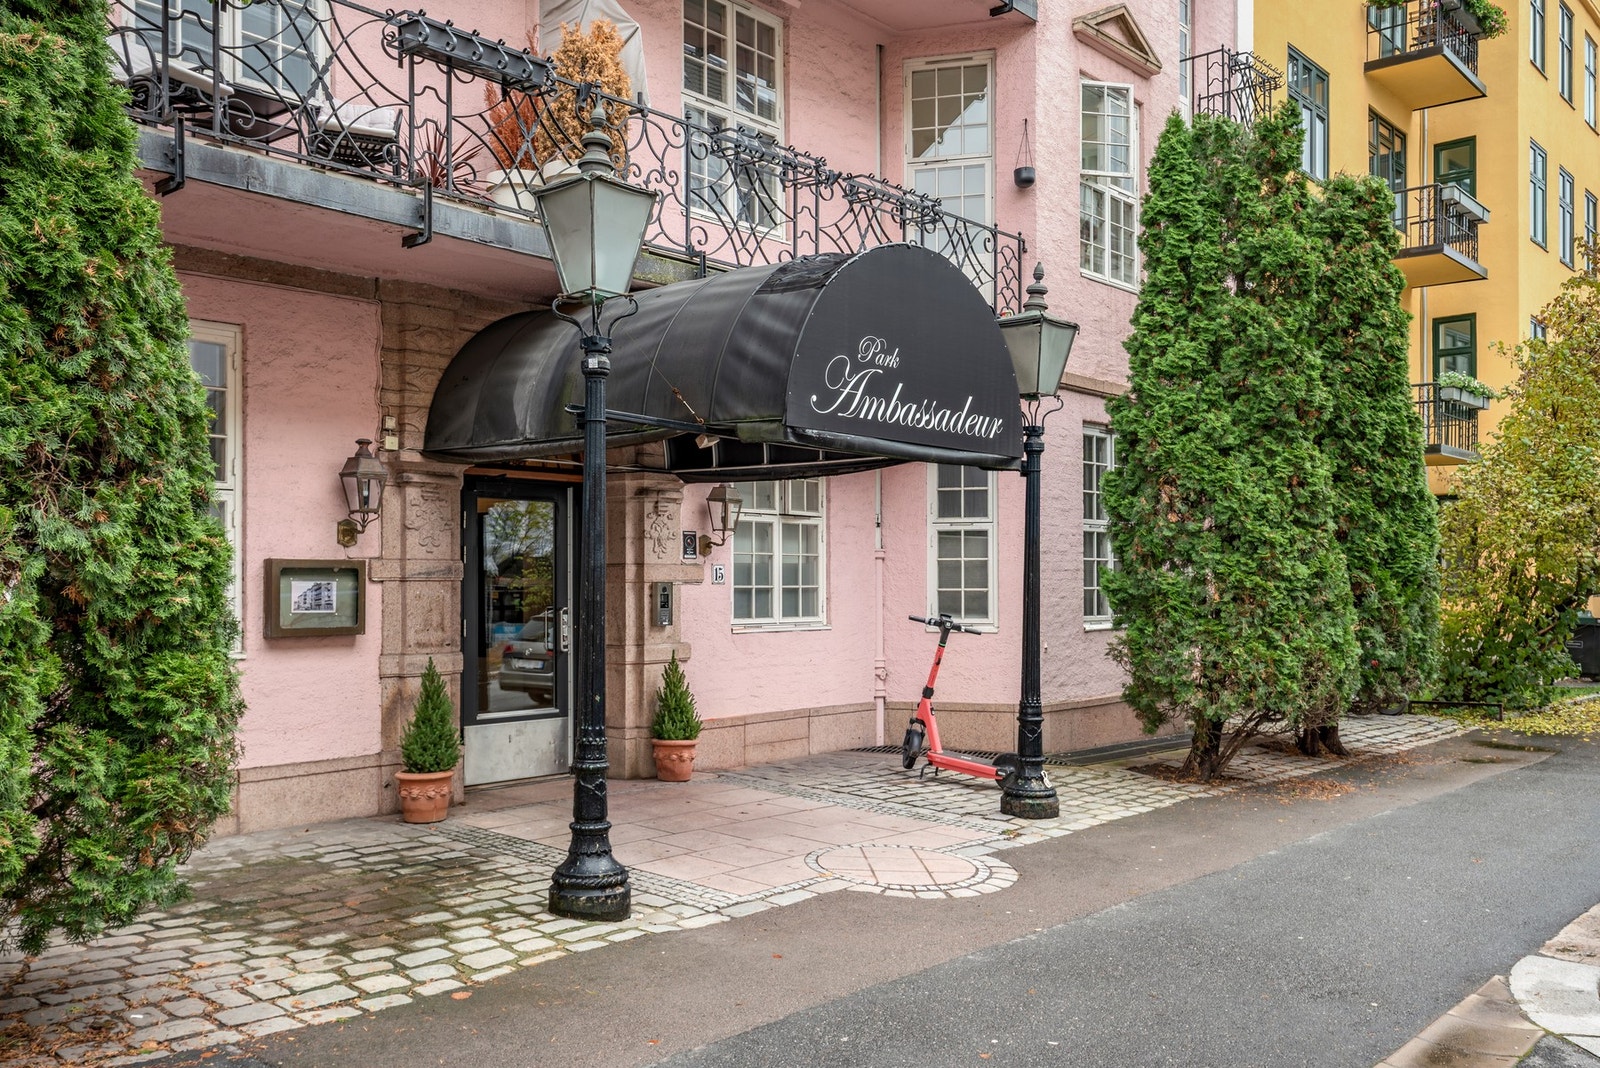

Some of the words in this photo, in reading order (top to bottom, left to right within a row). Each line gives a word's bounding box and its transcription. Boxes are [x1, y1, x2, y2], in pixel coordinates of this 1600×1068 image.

[858, 335, 900, 369] Park
[810, 355, 1003, 439] Ambassadeur
[714, 567, 724, 582] 15
